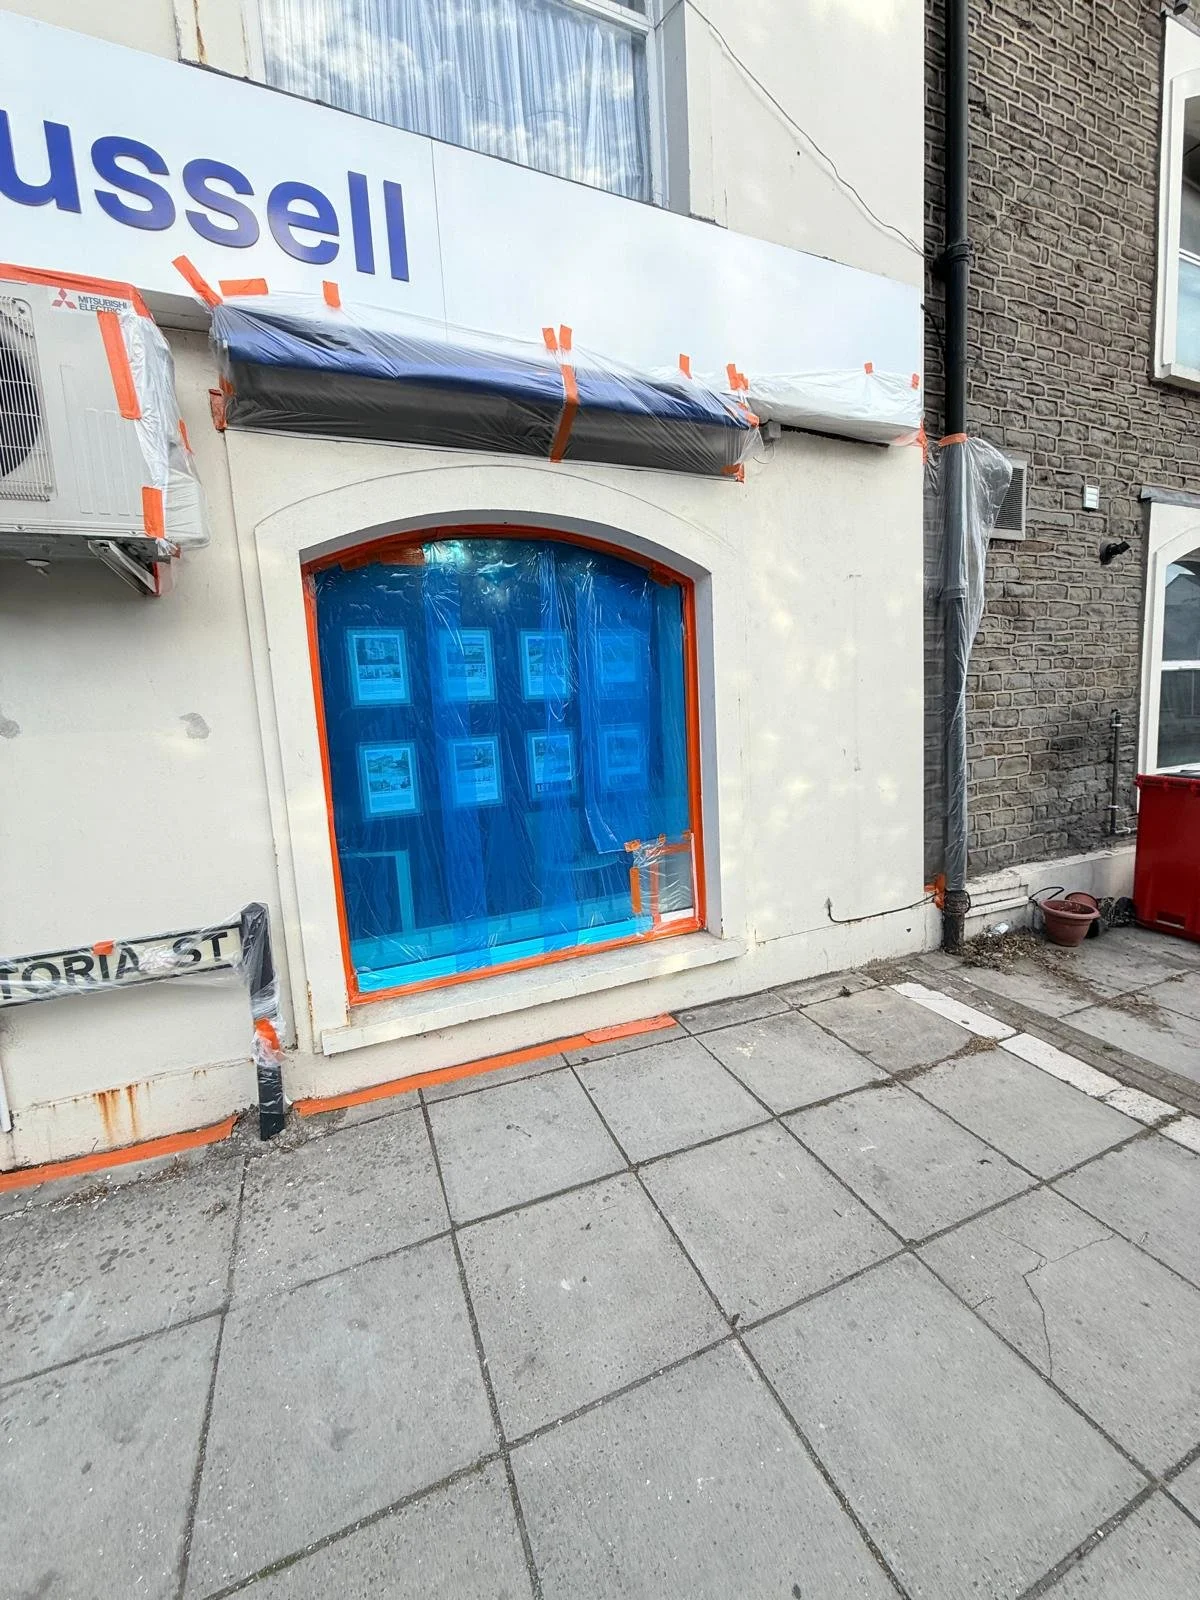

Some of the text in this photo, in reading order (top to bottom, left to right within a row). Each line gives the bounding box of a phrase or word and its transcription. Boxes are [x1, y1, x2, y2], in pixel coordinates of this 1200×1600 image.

[0, 110, 409, 282] ussell
[78, 296, 127, 309] MITSUBISHI
[172, 932, 228, 967] ST
